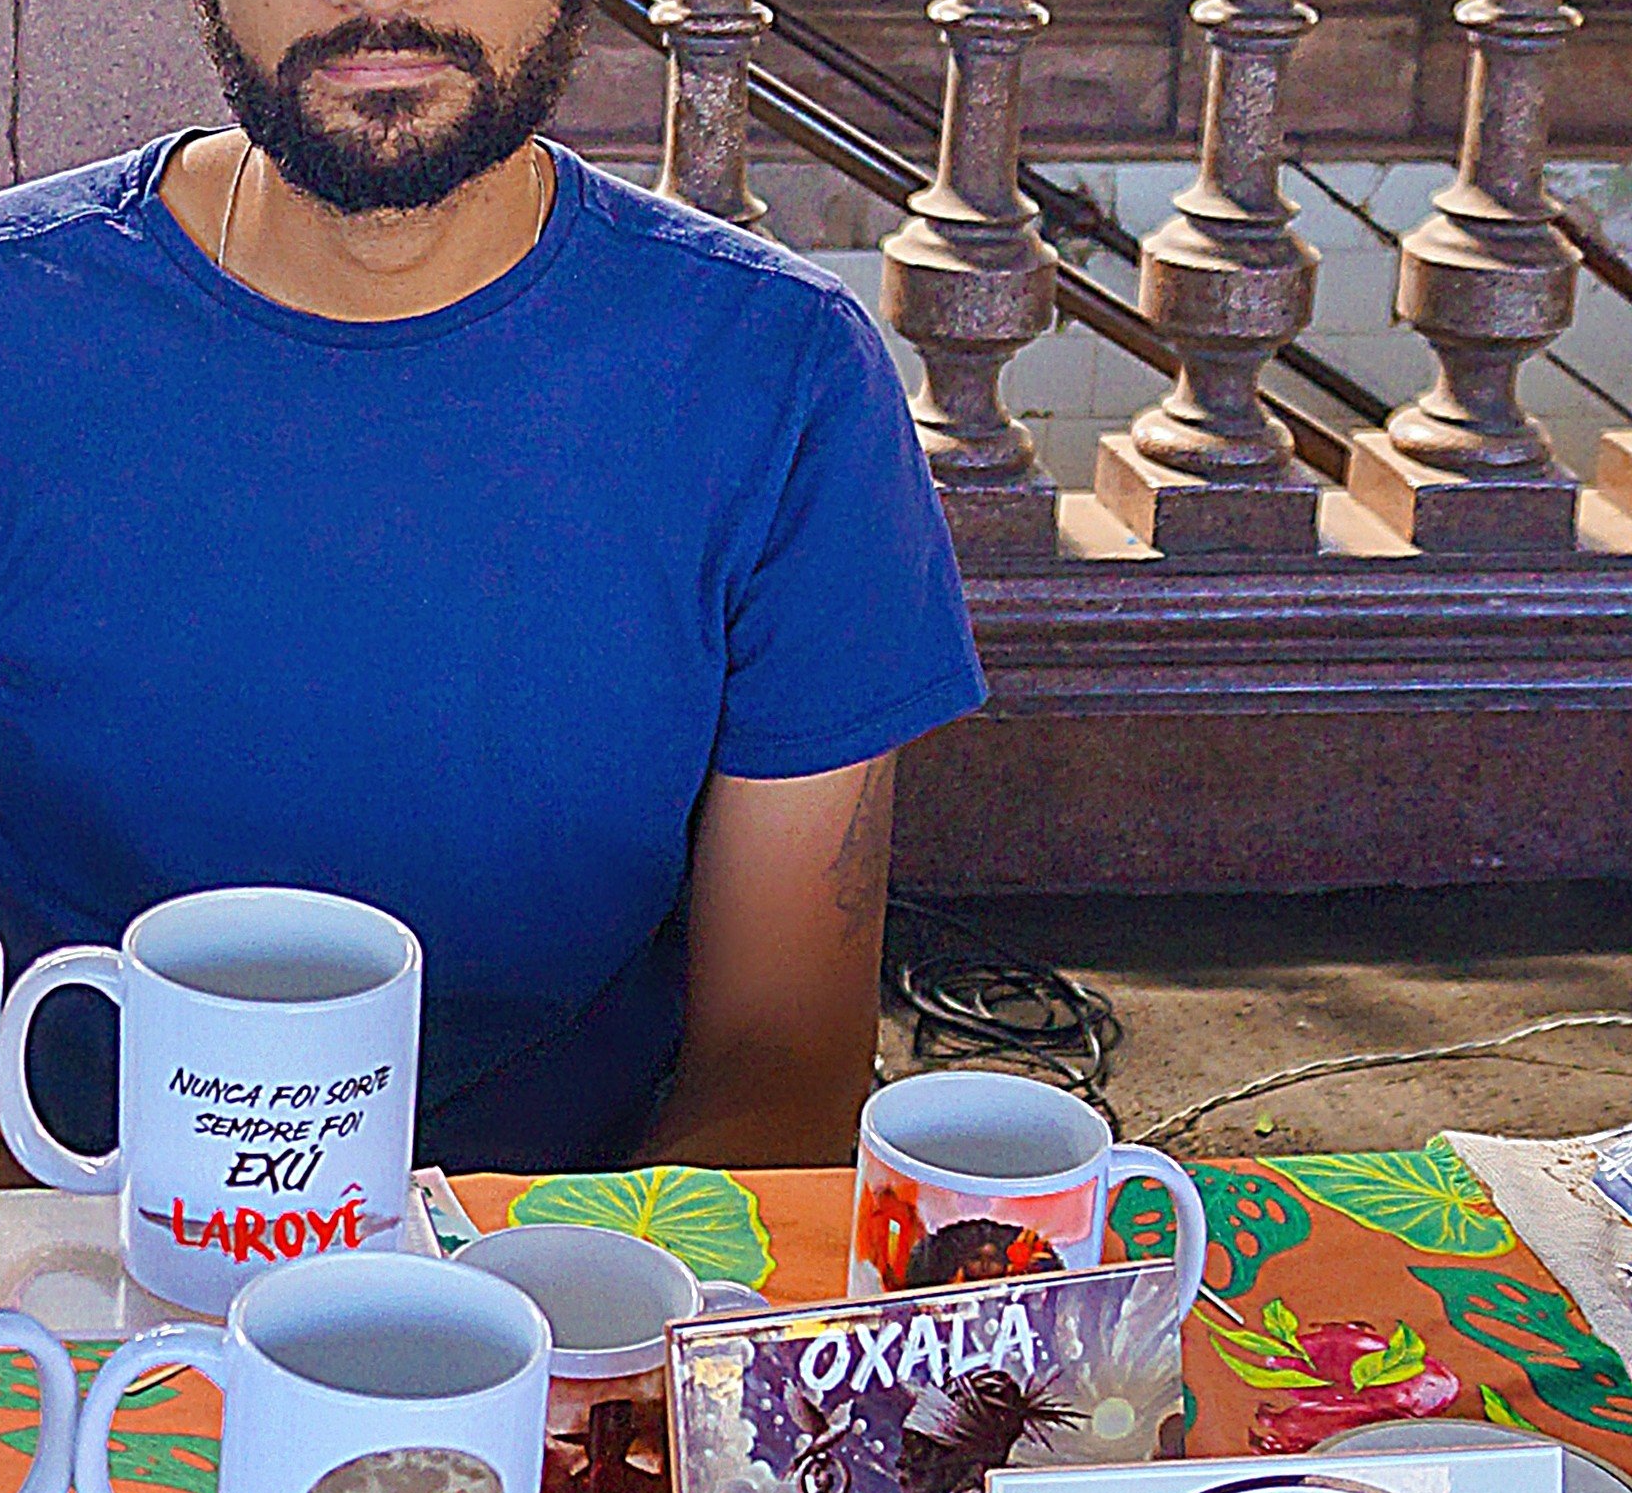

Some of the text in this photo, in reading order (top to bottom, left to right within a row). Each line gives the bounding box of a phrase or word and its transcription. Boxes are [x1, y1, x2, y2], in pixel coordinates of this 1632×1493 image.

[169, 1065, 393, 1109] NUNCA FOI SORTE
[194, 1110, 365, 1144] SEMPRE FOI
[224, 1144, 325, 1194] EXÚ
[799, 1284, 1038, 1394] OXALÁ
